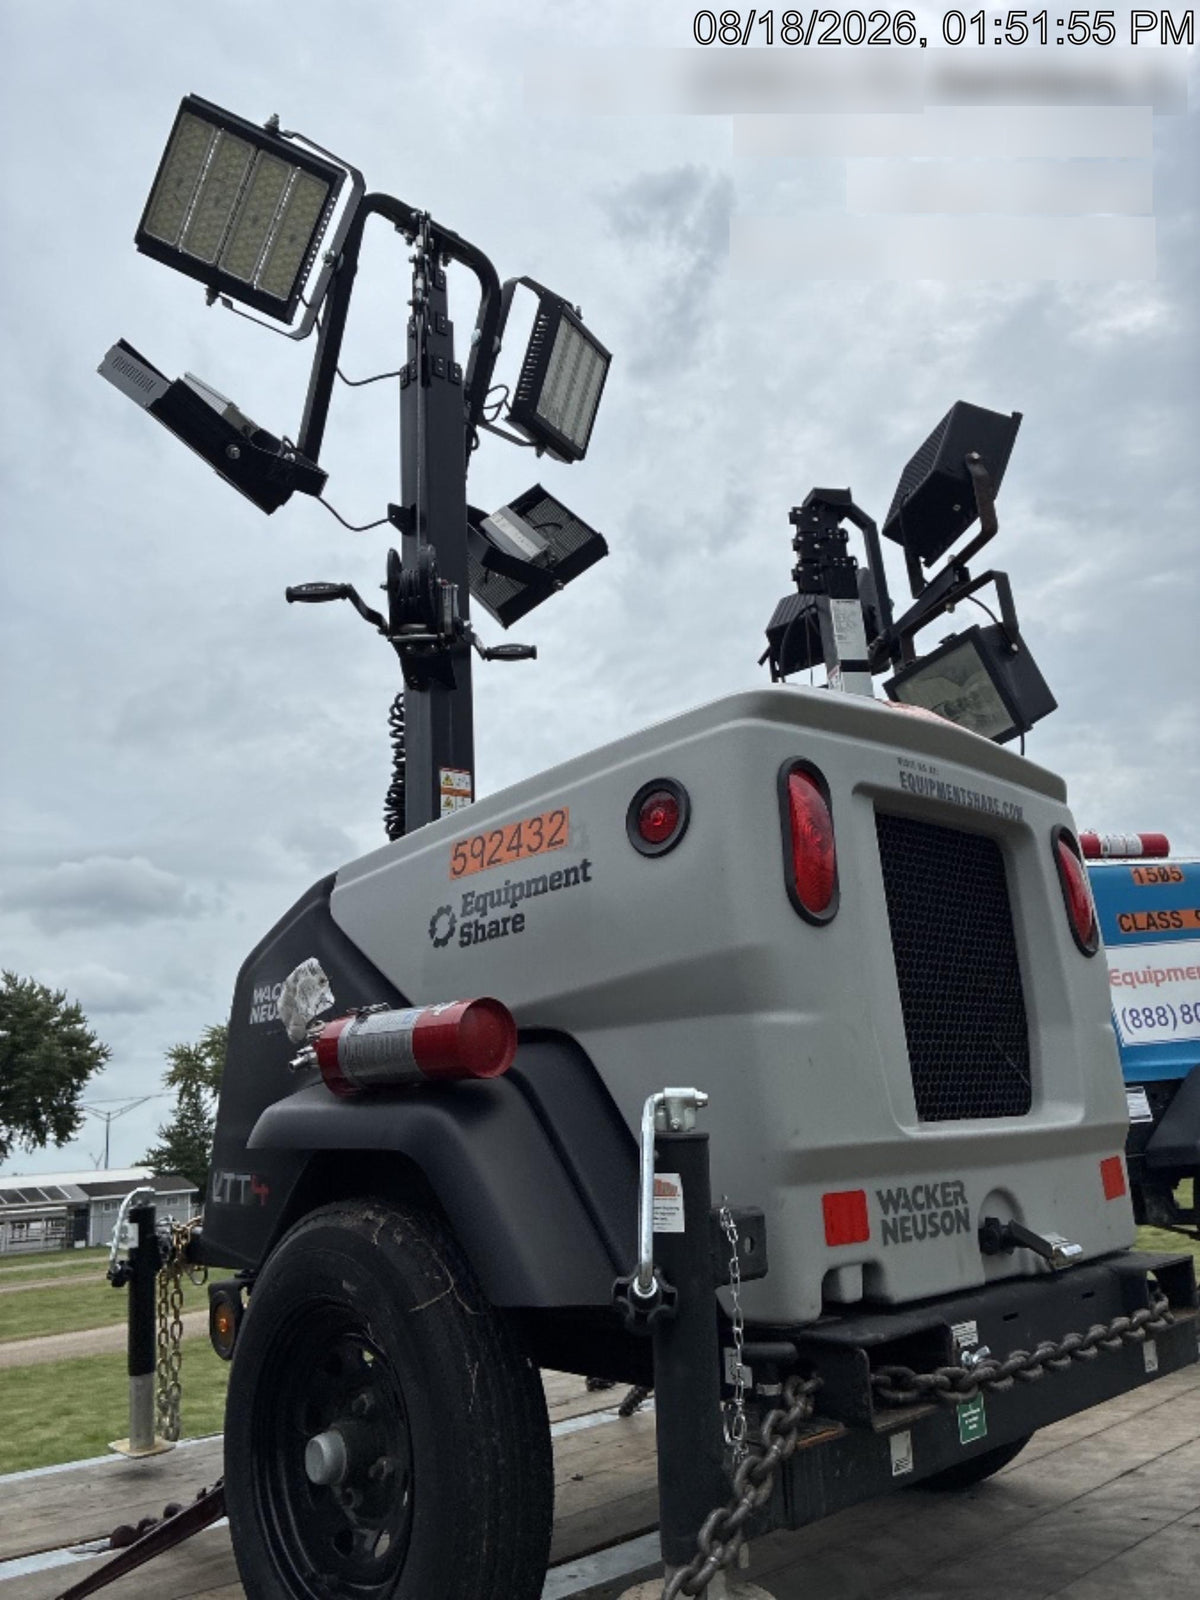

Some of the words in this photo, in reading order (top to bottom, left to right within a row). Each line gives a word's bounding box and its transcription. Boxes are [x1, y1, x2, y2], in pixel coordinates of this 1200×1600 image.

[452, 810, 566, 876] 592432
[460, 858, 592, 918] Equipment
[1133, 867, 1183, 884] 1505
[458, 912, 525, 948] Share
[1119, 910, 1183, 932] CLASS
[253, 982, 282, 1005] WAC
[1109, 966, 1200, 989] Equipme
[876, 1180, 968, 1215] WACKER
[881, 1207, 971, 1247] NEUSON
